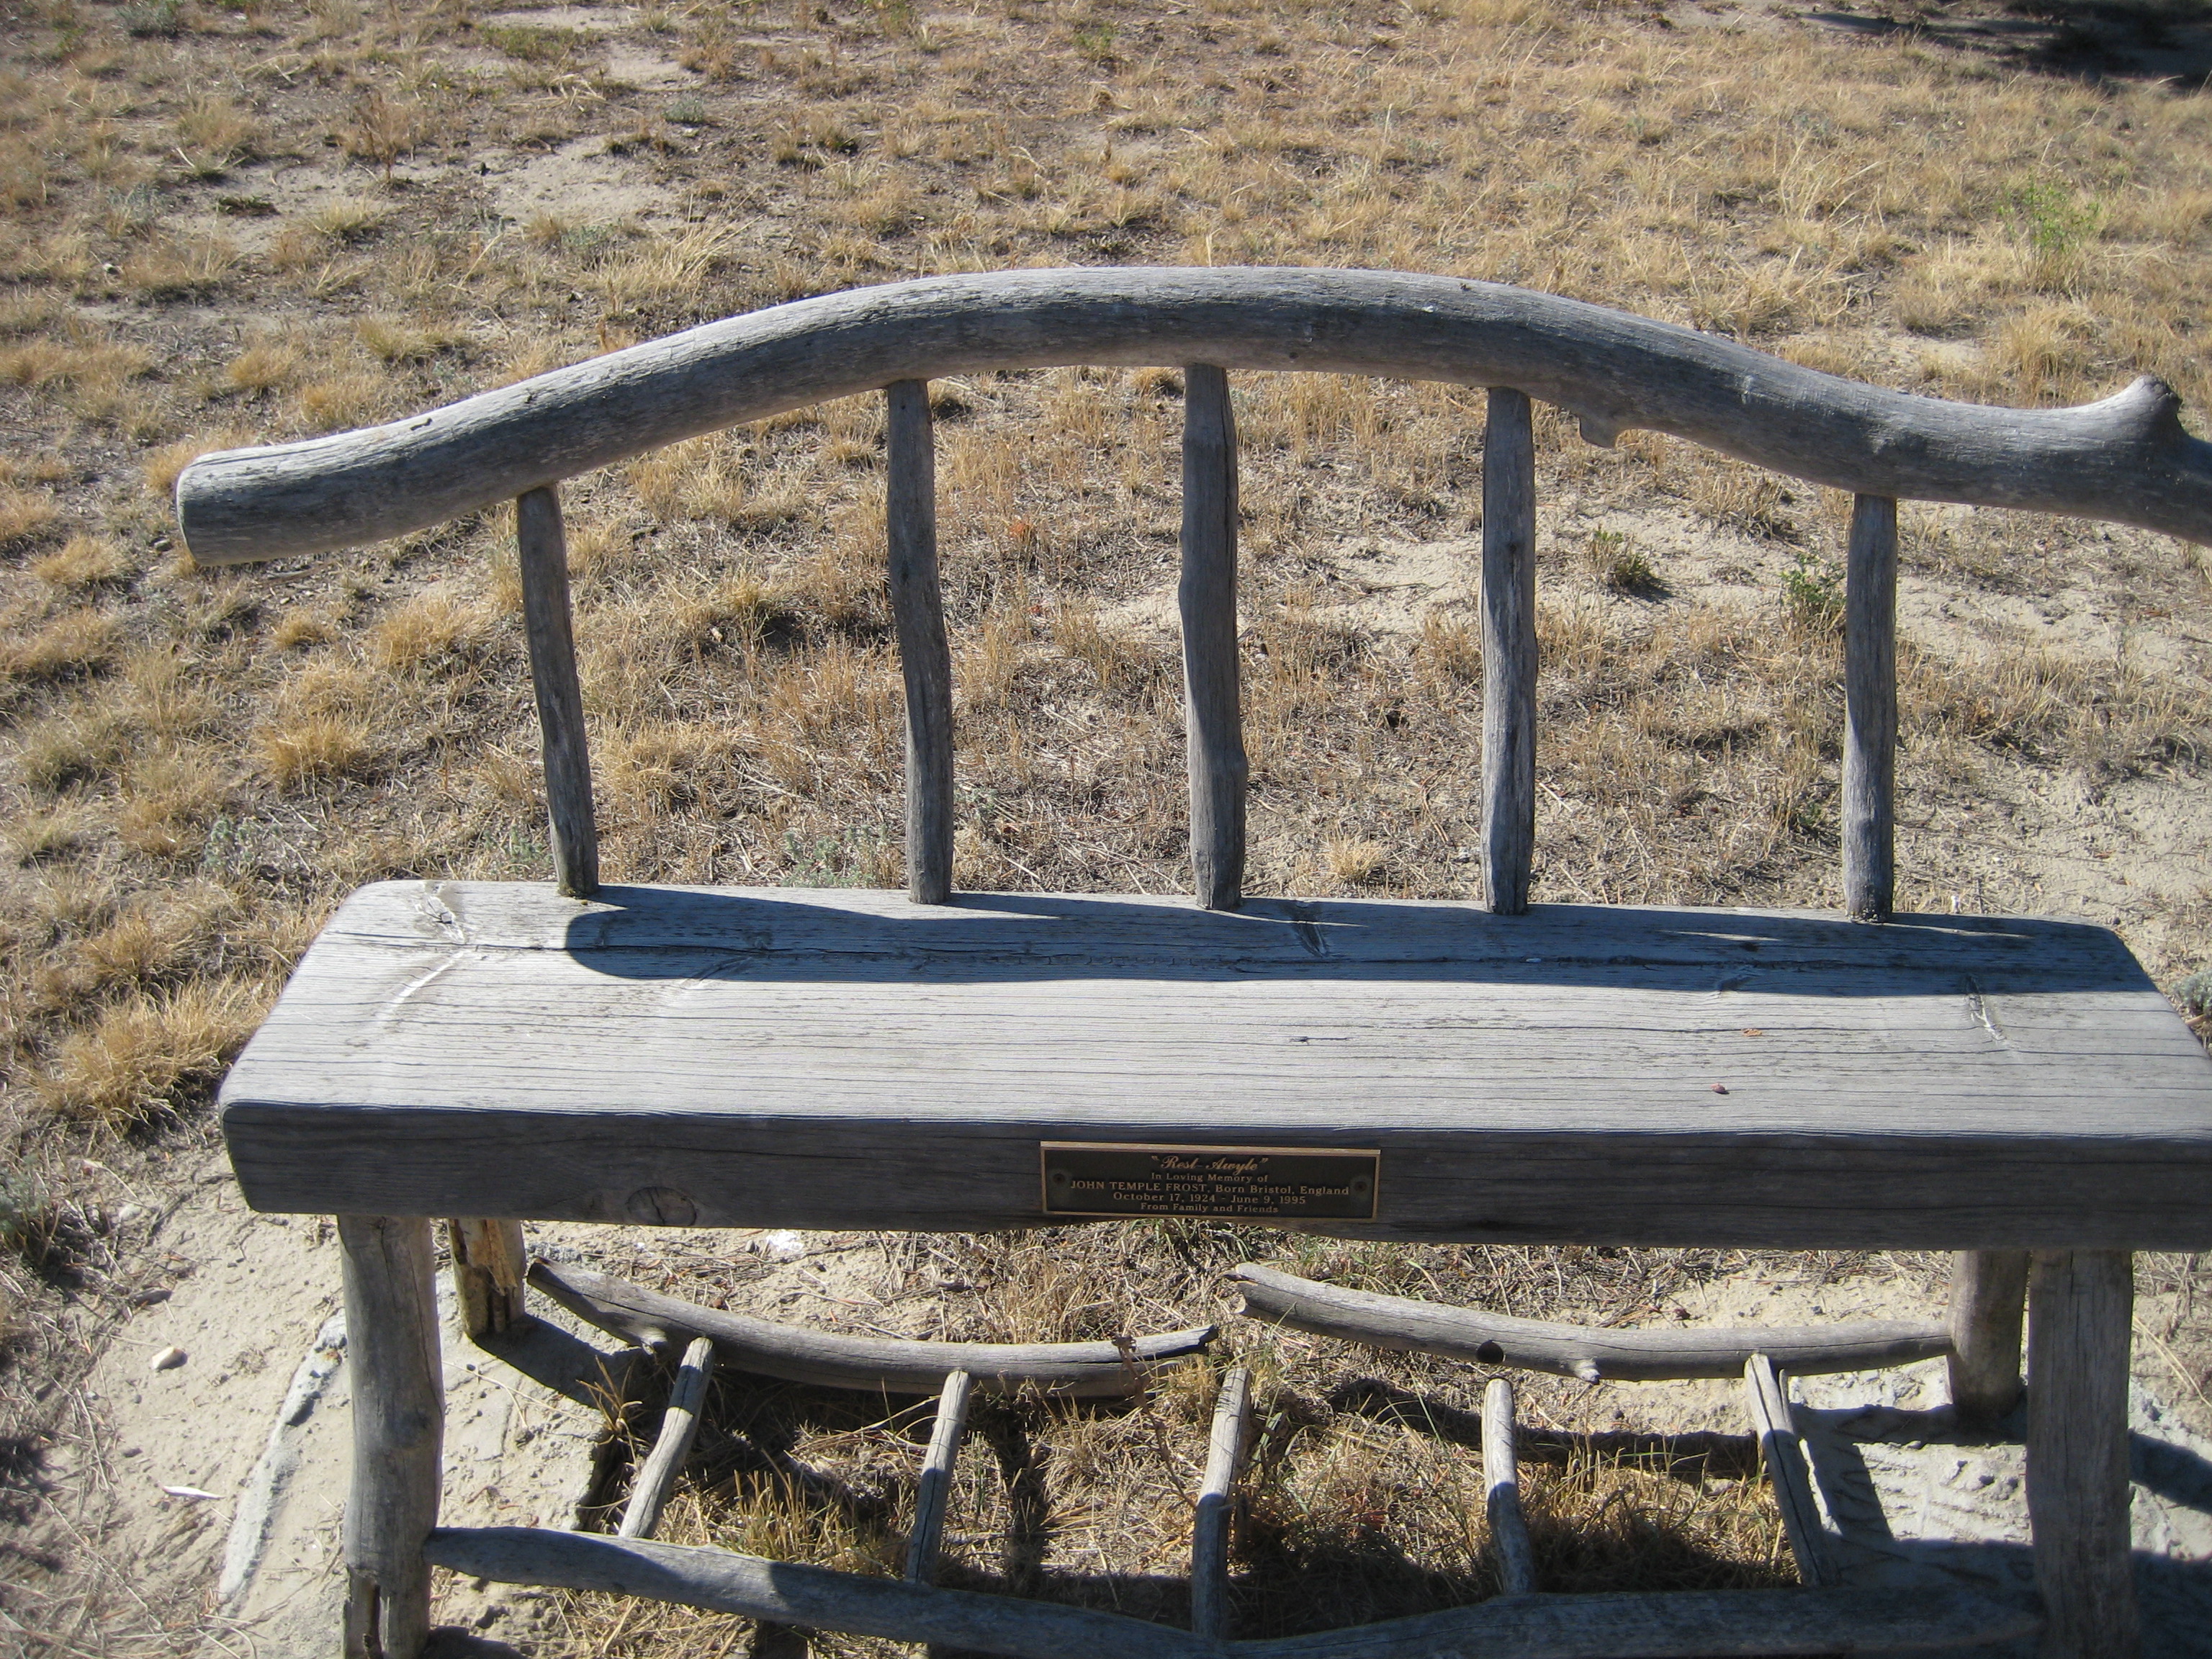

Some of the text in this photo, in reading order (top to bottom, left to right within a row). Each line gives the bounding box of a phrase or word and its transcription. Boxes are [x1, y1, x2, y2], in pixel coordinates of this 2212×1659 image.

[1166, 1173, 1203, 1182] Loving
[1208, 1174, 1252, 1183] Memory
[1071, 1181, 1349, 1196] JOHN TEMPLE FROST, Born Bristol, England
[1113, 1192, 1164, 1201] October
[1169, 1193, 1184, 1202] 17,
[1190, 1194, 1215, 1202] 1924
[1231, 1195, 1259, 1204] June
[1264, 1196, 1274, 1205] 9,
[1280, 1196, 1306, 1205] 1995
[1173, 1203, 1208, 1213] Family
